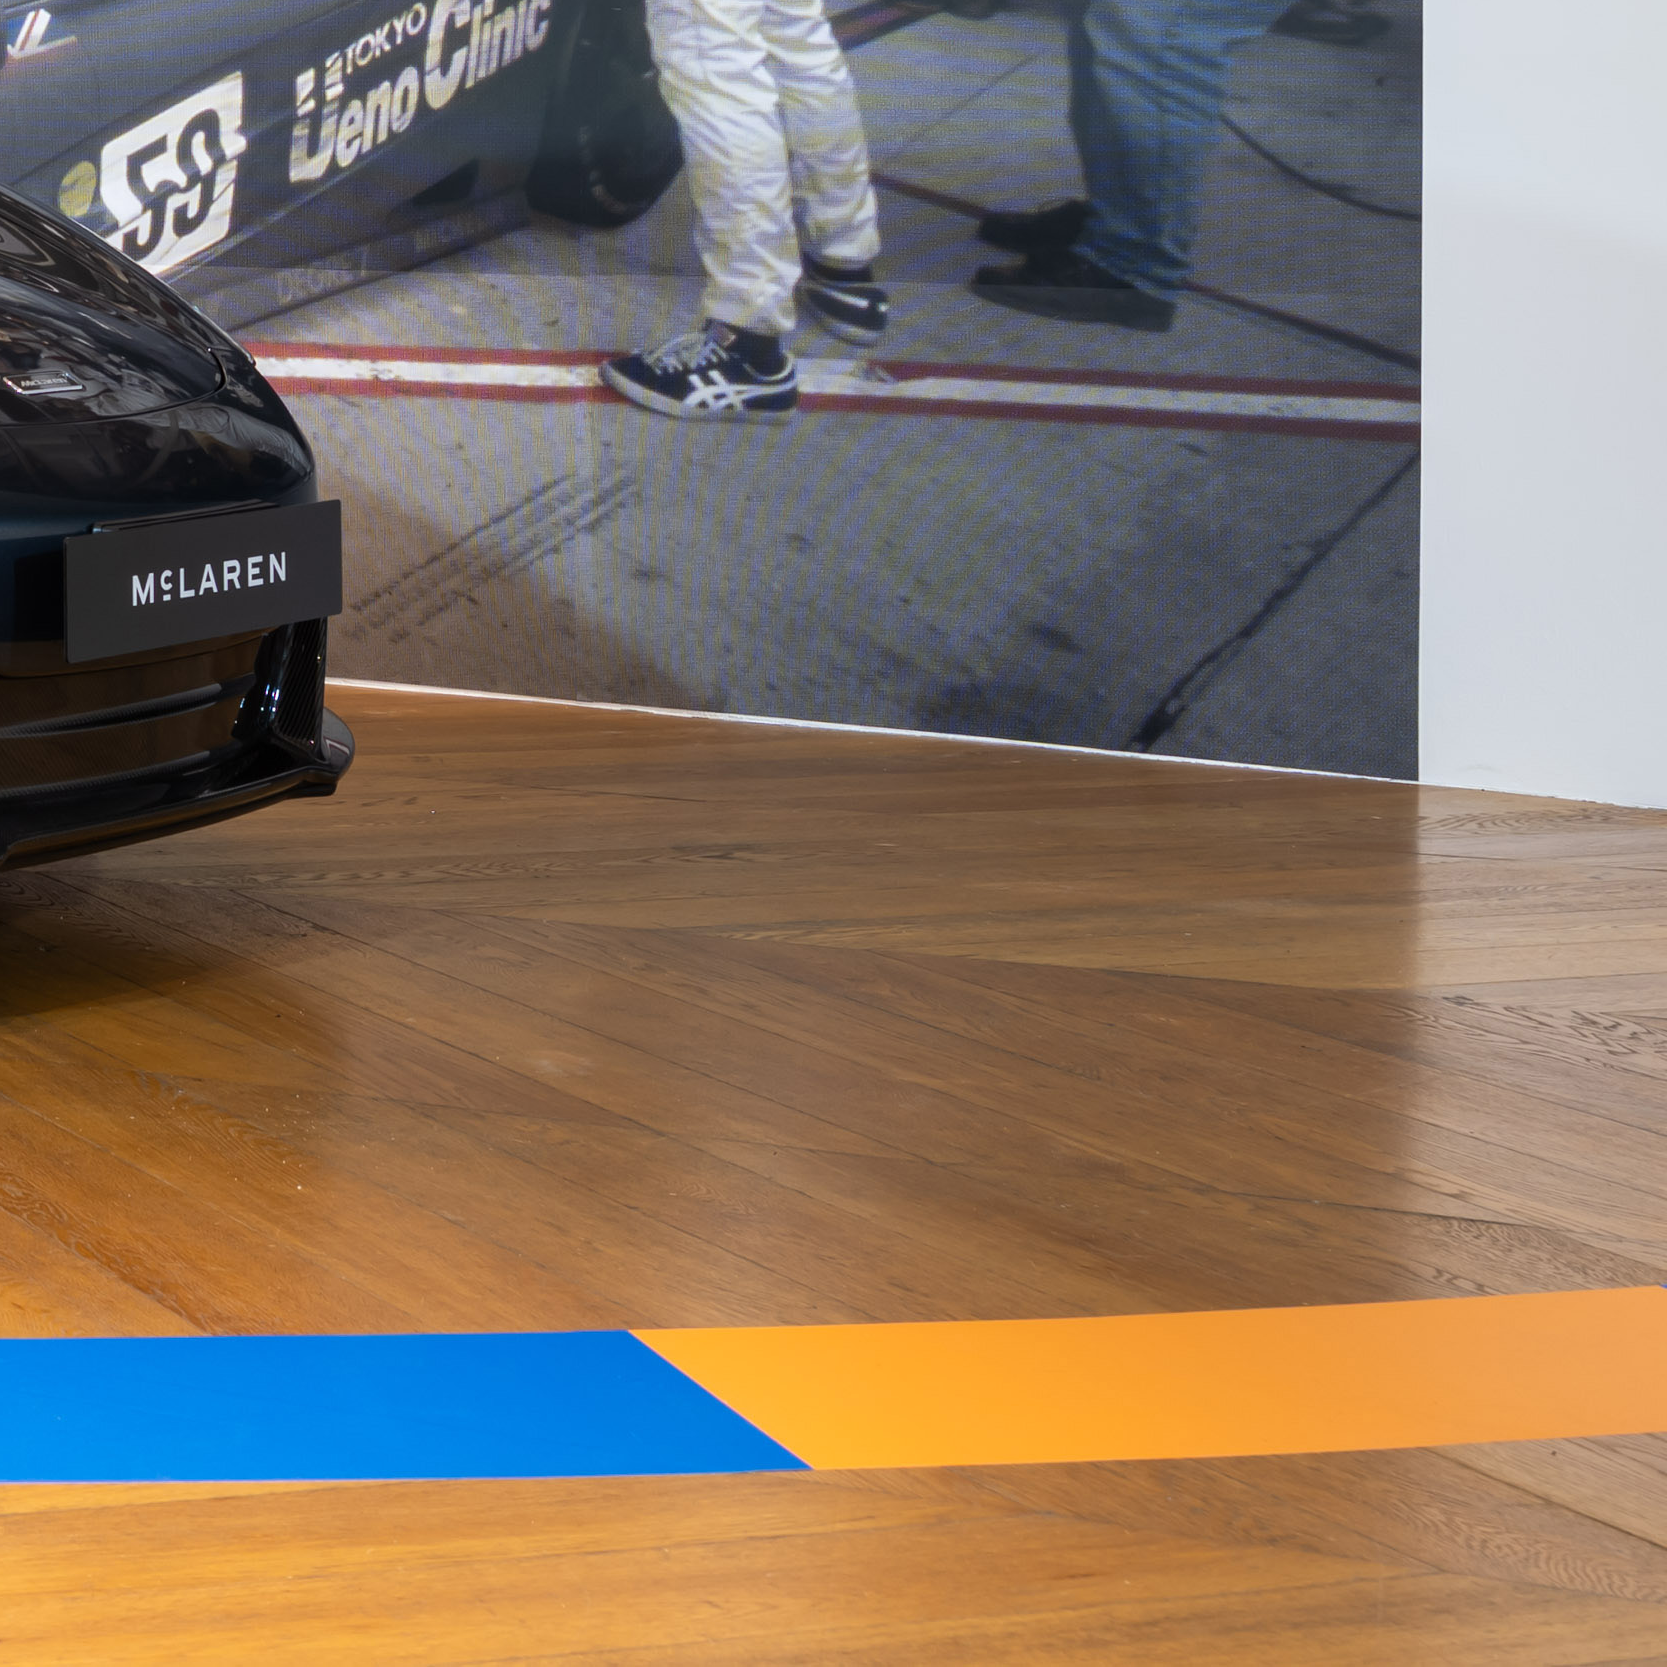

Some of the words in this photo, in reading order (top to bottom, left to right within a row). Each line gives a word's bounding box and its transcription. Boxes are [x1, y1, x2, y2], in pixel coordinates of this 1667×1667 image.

[344, 1, 428, 75] TOKYO
[289, 51, 420, 184] Ueno
[122, 107, 227, 263] 59
